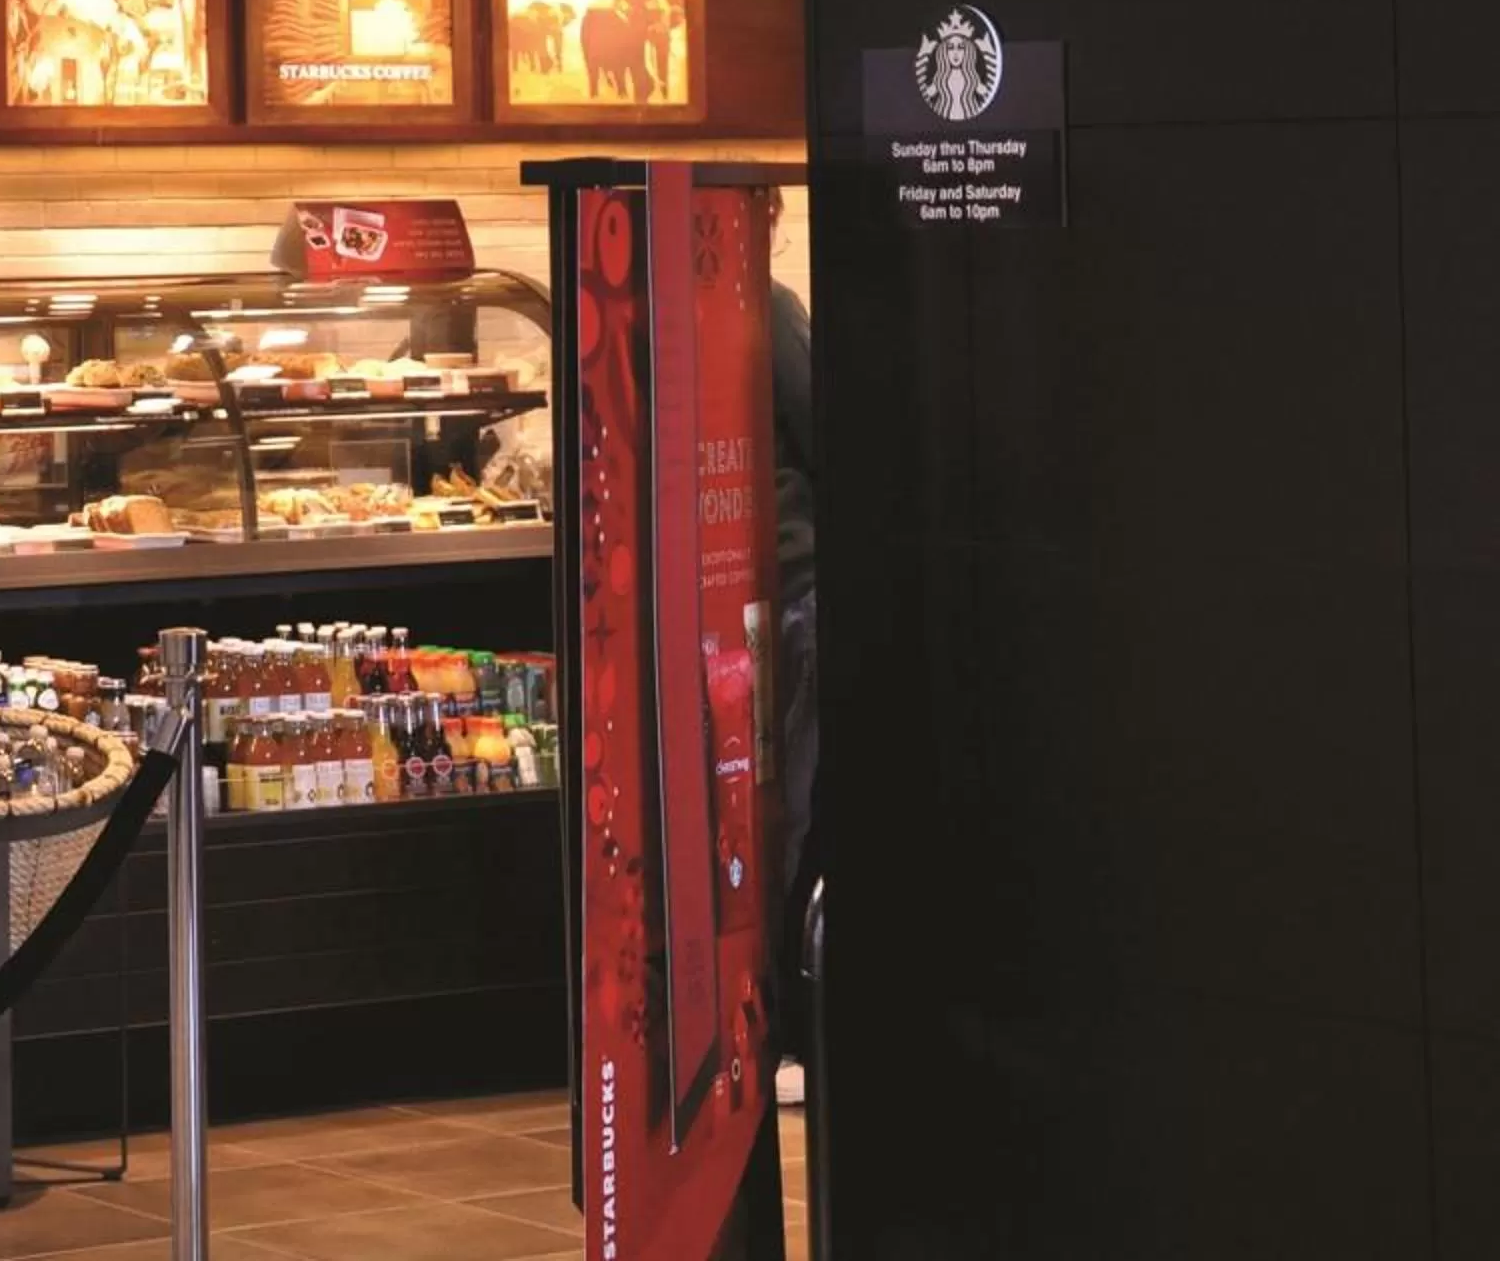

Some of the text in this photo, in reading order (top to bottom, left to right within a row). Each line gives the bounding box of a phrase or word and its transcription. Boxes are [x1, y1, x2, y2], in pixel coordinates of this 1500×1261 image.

[279, 63, 372, 80] STARBUCKS
[891, 139, 1028, 159] Sunday thru Thursday
[922, 157, 996, 175] 6am to 8pm
[899, 184, 1022, 203] Friday and Saturday
[920, 204, 1000, 222] 6am to 10pm
[601, 1059, 617, 1261] STARBUCKS
